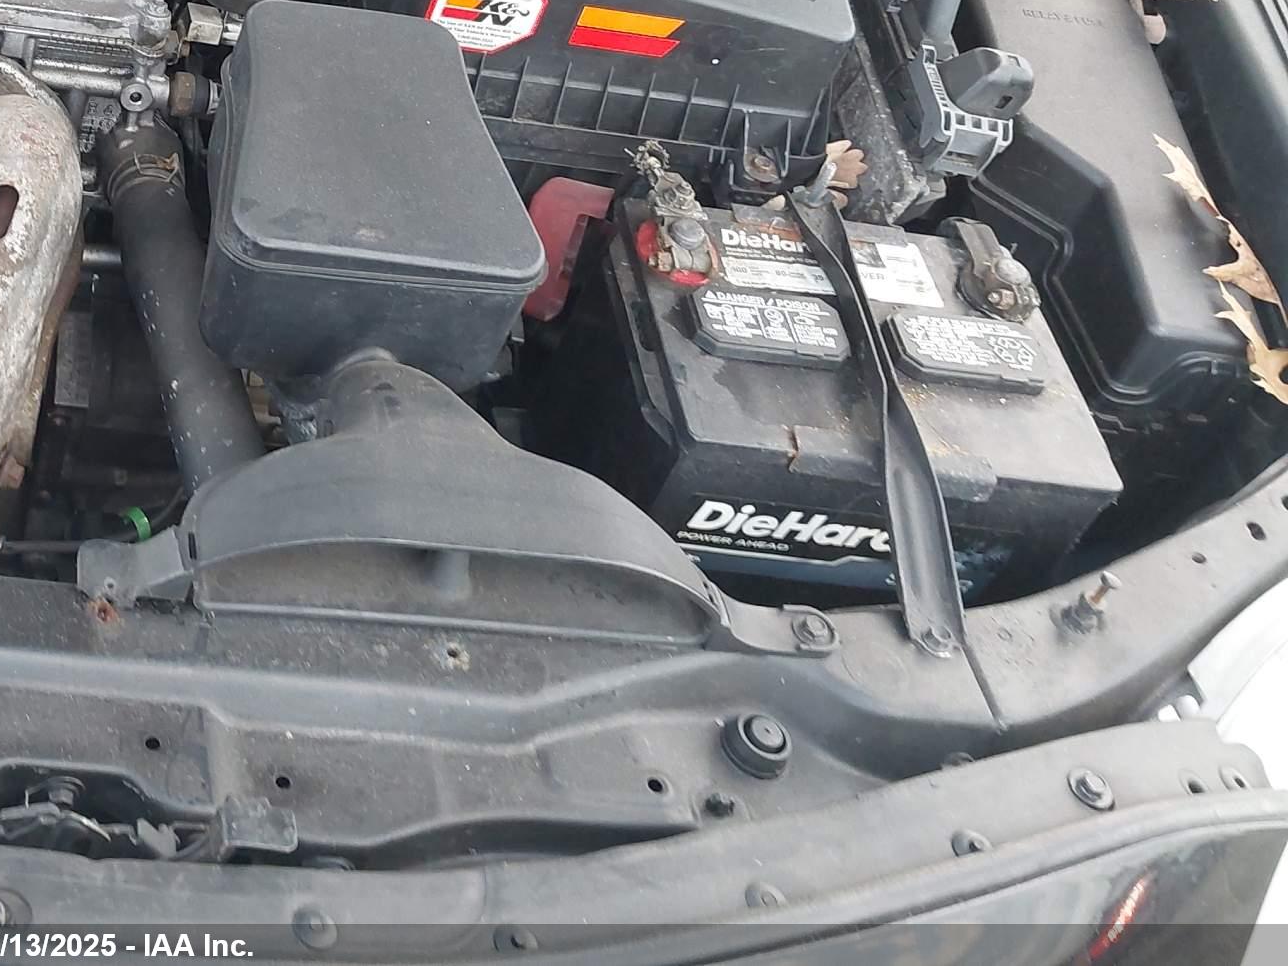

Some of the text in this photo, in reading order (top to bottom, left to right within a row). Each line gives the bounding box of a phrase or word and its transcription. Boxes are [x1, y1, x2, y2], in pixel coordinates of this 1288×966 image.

[720, 228, 812, 253] DieHar
[716, 291, 766, 306] DANGER
[775, 298, 821, 313] POISON
[677, 531, 790, 552] POWER AHEAD
